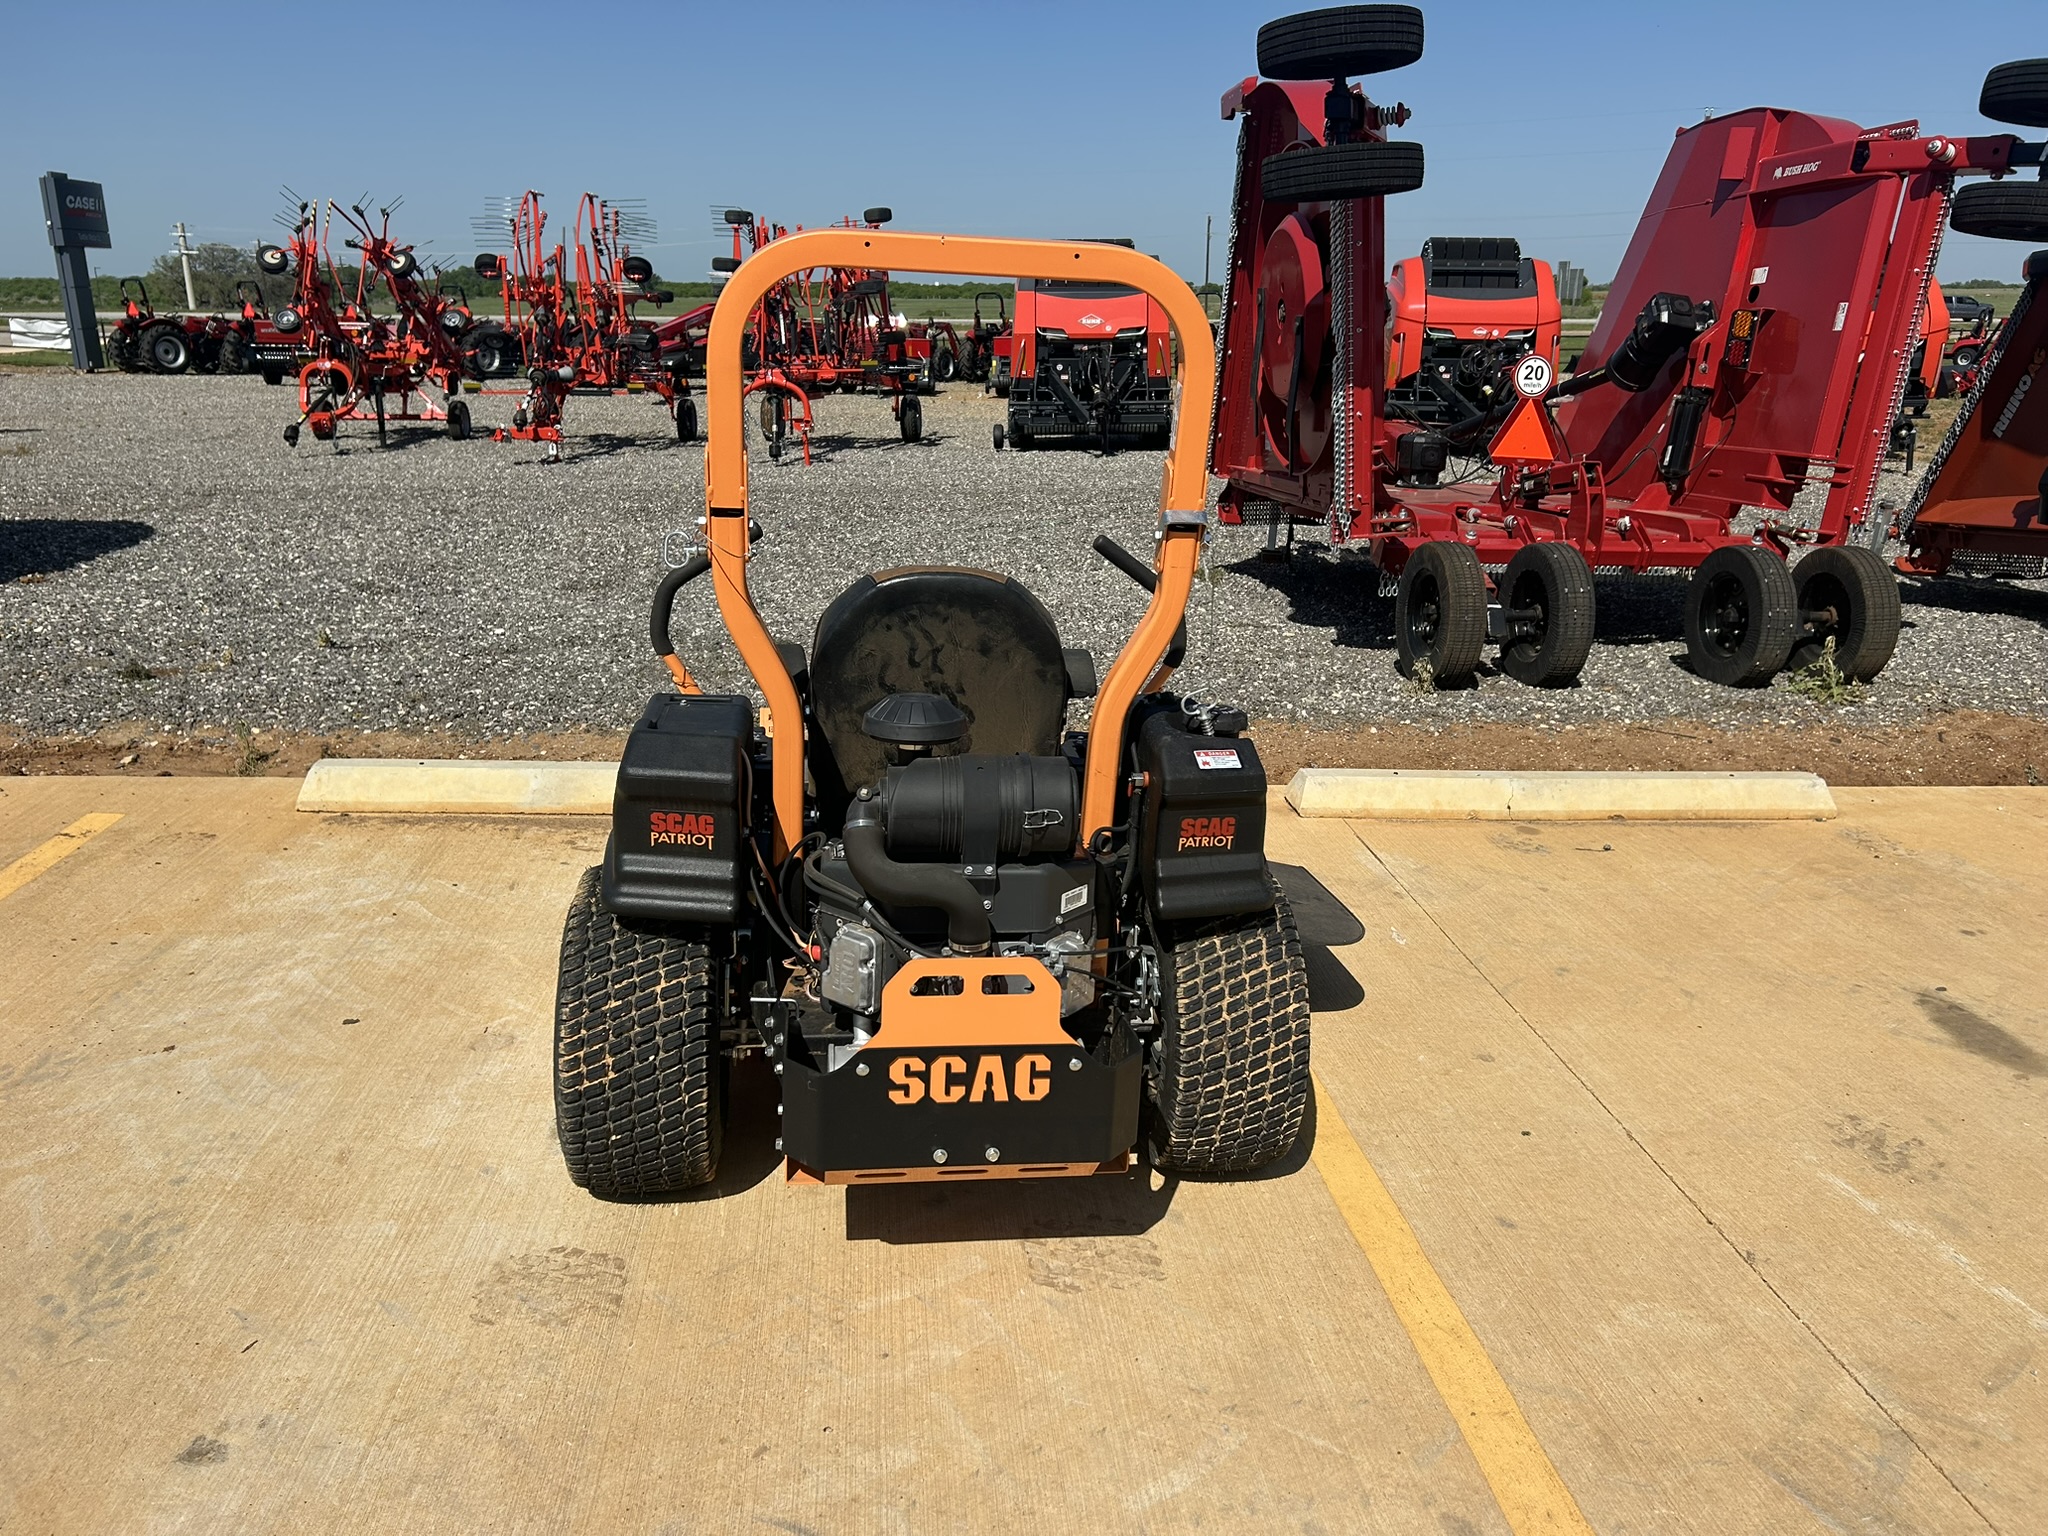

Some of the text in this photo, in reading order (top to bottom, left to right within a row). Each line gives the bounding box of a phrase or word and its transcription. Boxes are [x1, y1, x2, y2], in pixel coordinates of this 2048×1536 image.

[1783, 162, 1819, 177] BUSH HOG
[66, 195, 95, 210] CASE
[1524, 365, 1544, 381] 20
[1992, 347, 2046, 438] RHINO AG
[650, 812, 715, 835] SCAG
[1181, 817, 1235, 837] SCAG
[650, 831, 715, 851] PATRIOT
[1178, 836, 1234, 852] PATRIOT
[888, 1053, 1051, 1105] SCAG
